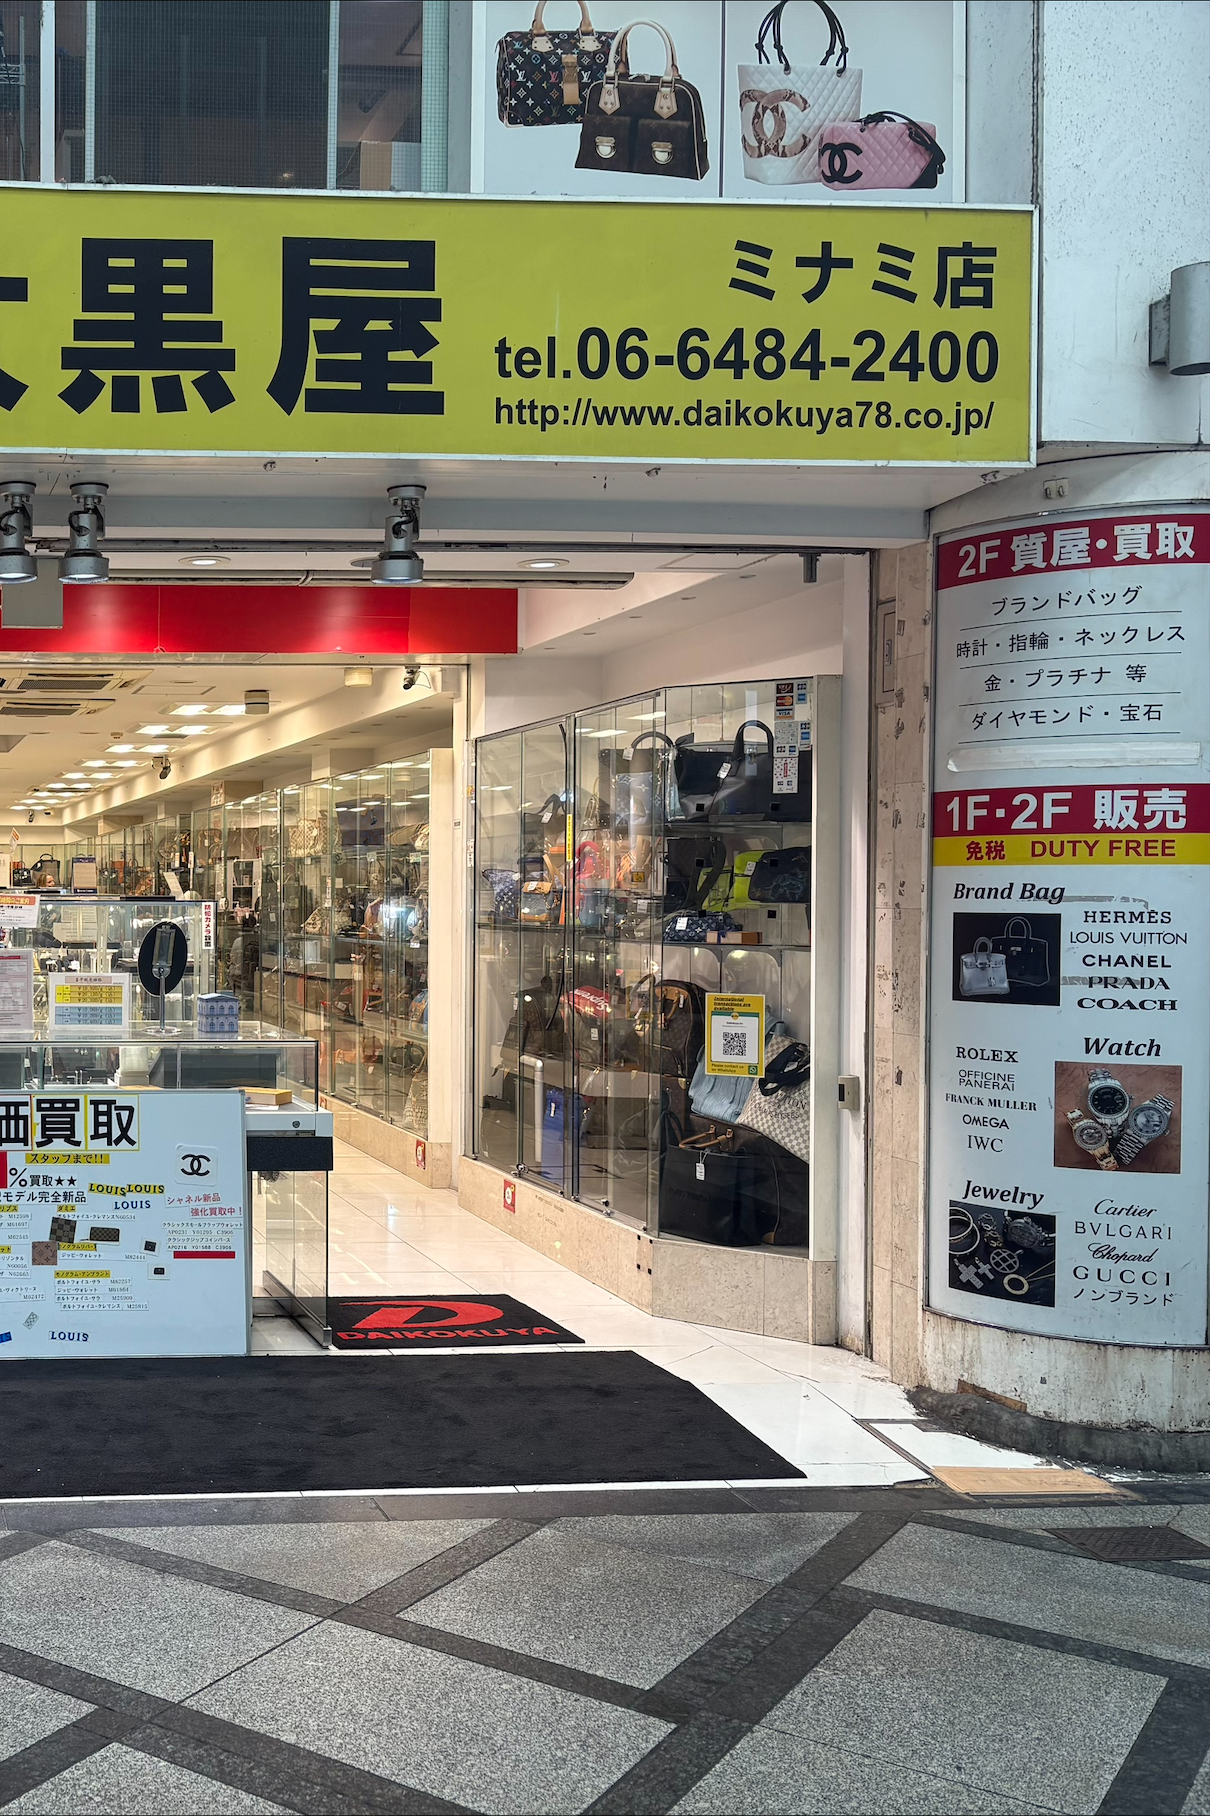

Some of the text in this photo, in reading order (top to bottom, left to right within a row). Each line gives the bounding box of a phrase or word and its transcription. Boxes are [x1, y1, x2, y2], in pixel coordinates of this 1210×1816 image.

[728, 239, 998, 310] ミナミ店
[494, 326, 1000, 384] tel.06-6484-2400
[494, 397, 994, 436] http://www.daikokuya78.co.jp/
[958, 522, 1195, 578] 2F 質屋・買取
[992, 585, 1143, 616] ブランドバッグ
[956, 626, 1186, 659] 時計・指輪・ネックレス
[984, 664, 1148, 693] 金・プラチナ 等
[972, 703, 1164, 731] ダイヤモンド・宝石
[1093, 788, 1188, 831] 販売
[966, 839, 1176, 862] 免税 DUTY FREE
[953, 882, 1065, 905] Brand Bag
[1070, 931, 1188, 945] LOUIS VUITTON
[1082, 954, 1172, 968] CHANEL
[1088, 976, 1170, 990] PRADA
[1077, 997, 1178, 1011] COACH
[956, 1046, 1019, 1064] ROLEX
[1083, 1037, 1162, 1057] Watch
[958, 1069, 1015, 1083] OFFICINE
[958, 1078, 1015, 1091] PANERAI
[945, 1092, 1037, 1112] FRANCK MULLER
[962, 1114, 1010, 1130] OMEGA
[967, 1134, 1003, 1153] IWC
[89, 1183, 126, 1196] LOUIS
[127, 1184, 165, 1194] LOUIS
[167, 1192, 221, 1205] シャネル新品
[962, 1180, 1045, 1210] Jewelry
[114, 1200, 151, 1210] LOUIS
[1094, 1199, 1157, 1217] Cartier
[1075, 1221, 1172, 1240] BVLGARI
[1087, 1243, 1159, 1264] Chopard
[1073, 1265, 1171, 1286] GUCCI
[1073, 1288, 1175, 1307] ノンブランド
[50, 1331, 89, 1342] LOUIS
[336, 1327, 559, 1340] DAIKOKUYA
